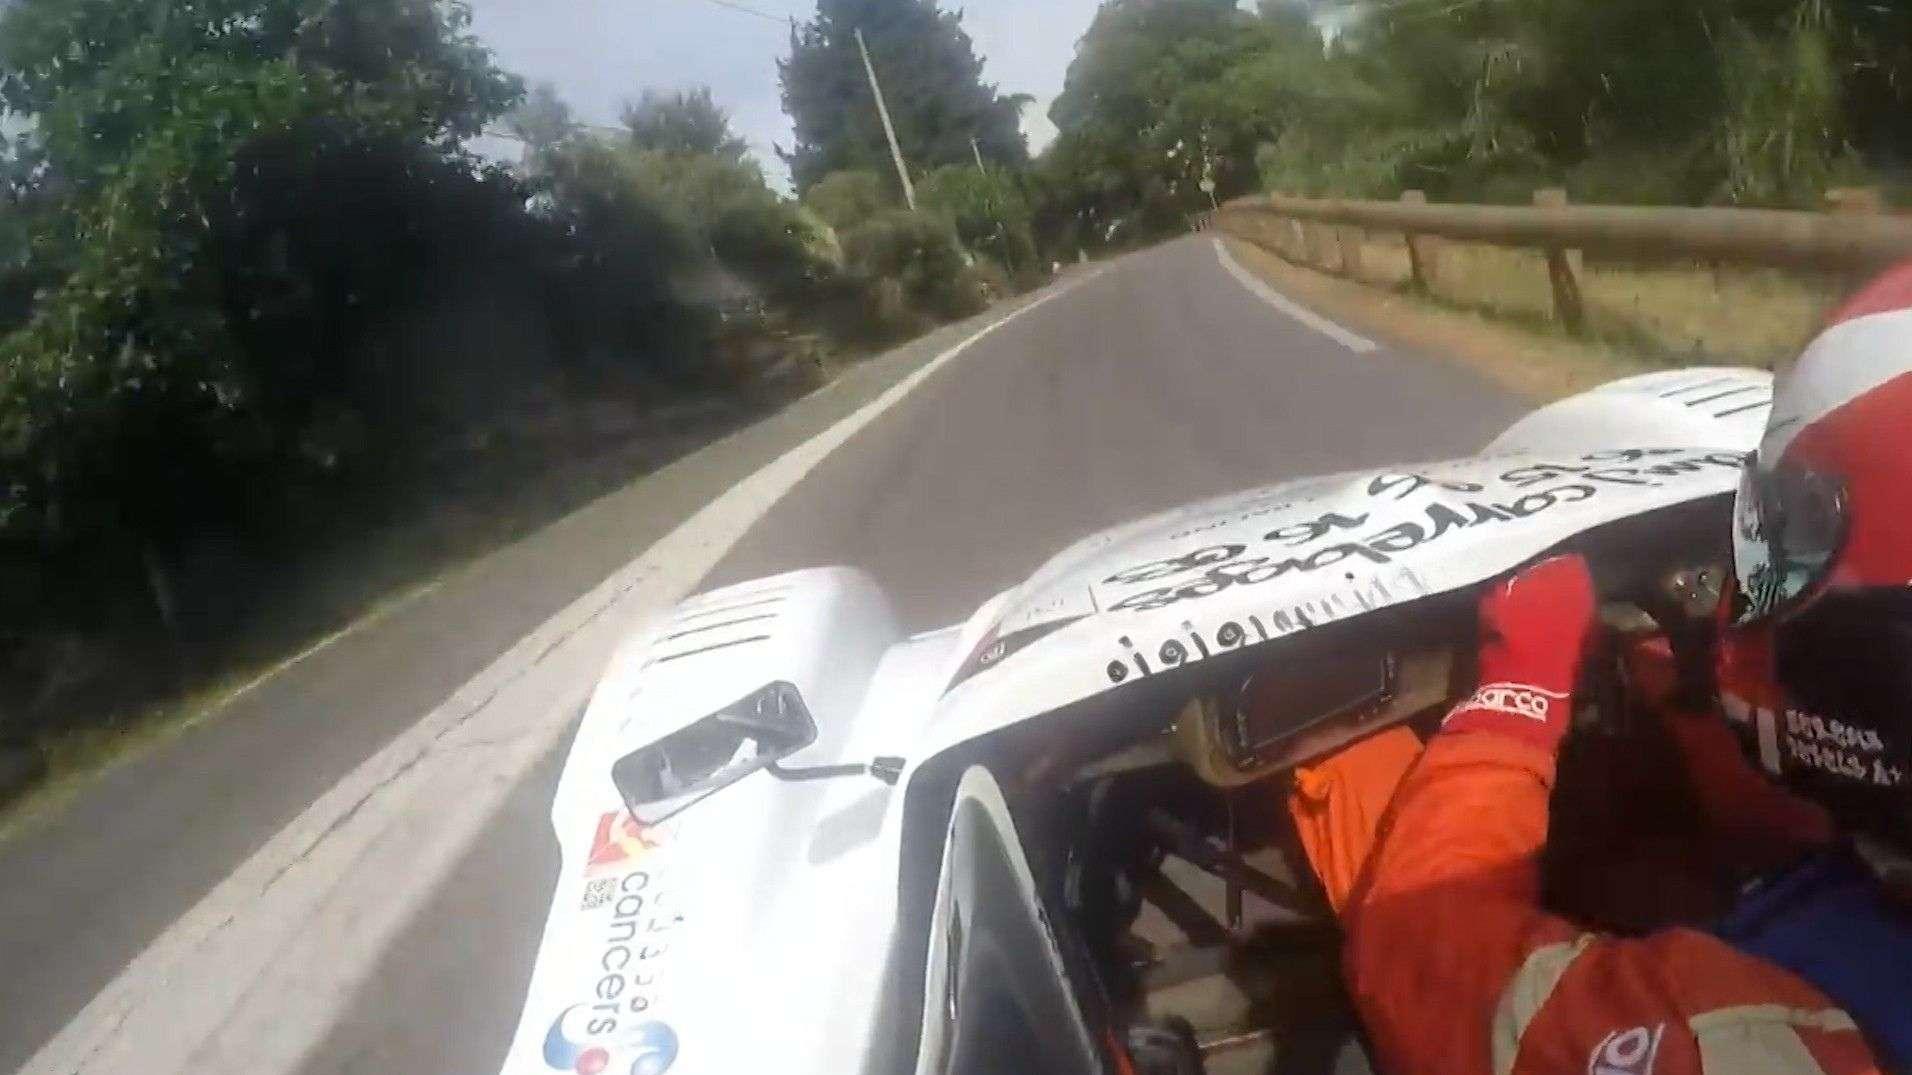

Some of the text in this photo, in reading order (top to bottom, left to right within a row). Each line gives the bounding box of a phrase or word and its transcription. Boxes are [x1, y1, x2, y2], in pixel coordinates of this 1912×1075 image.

[1107, 485, 1595, 612] carrelages
[1263, 513, 1370, 547] 16
[586, 871, 650, 1036] cancers
